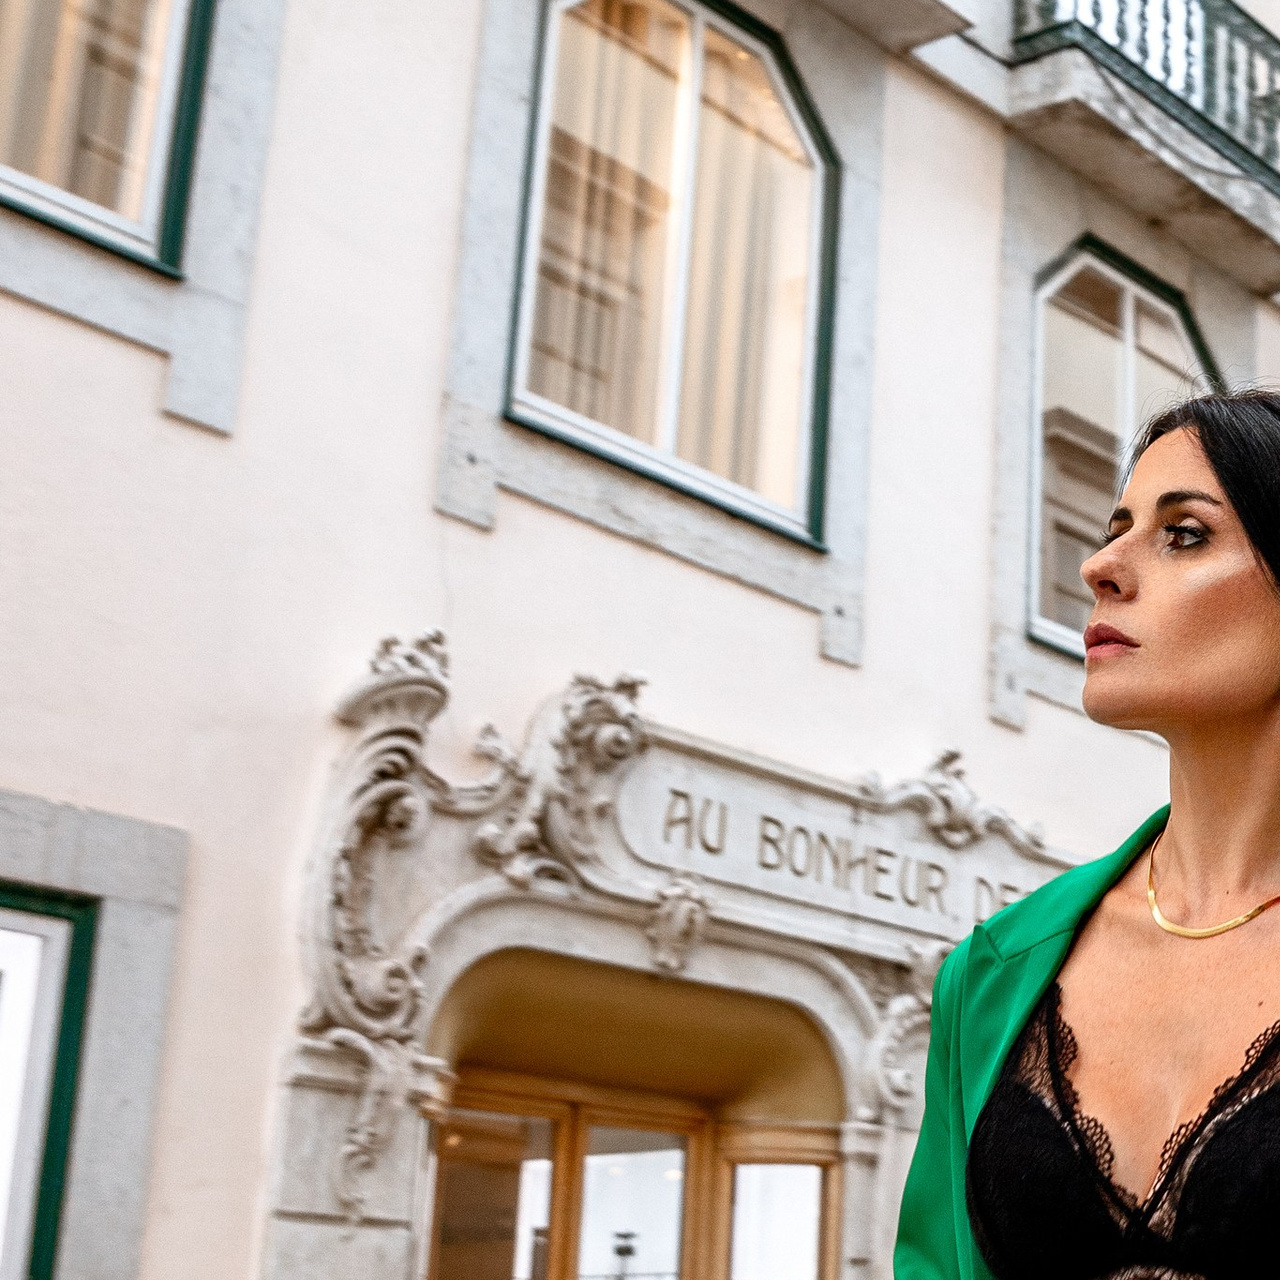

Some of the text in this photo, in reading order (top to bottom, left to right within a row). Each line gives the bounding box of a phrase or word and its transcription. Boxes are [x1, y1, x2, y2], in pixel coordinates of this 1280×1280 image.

[663, 787, 1034, 924] AU BONHEUR DE
